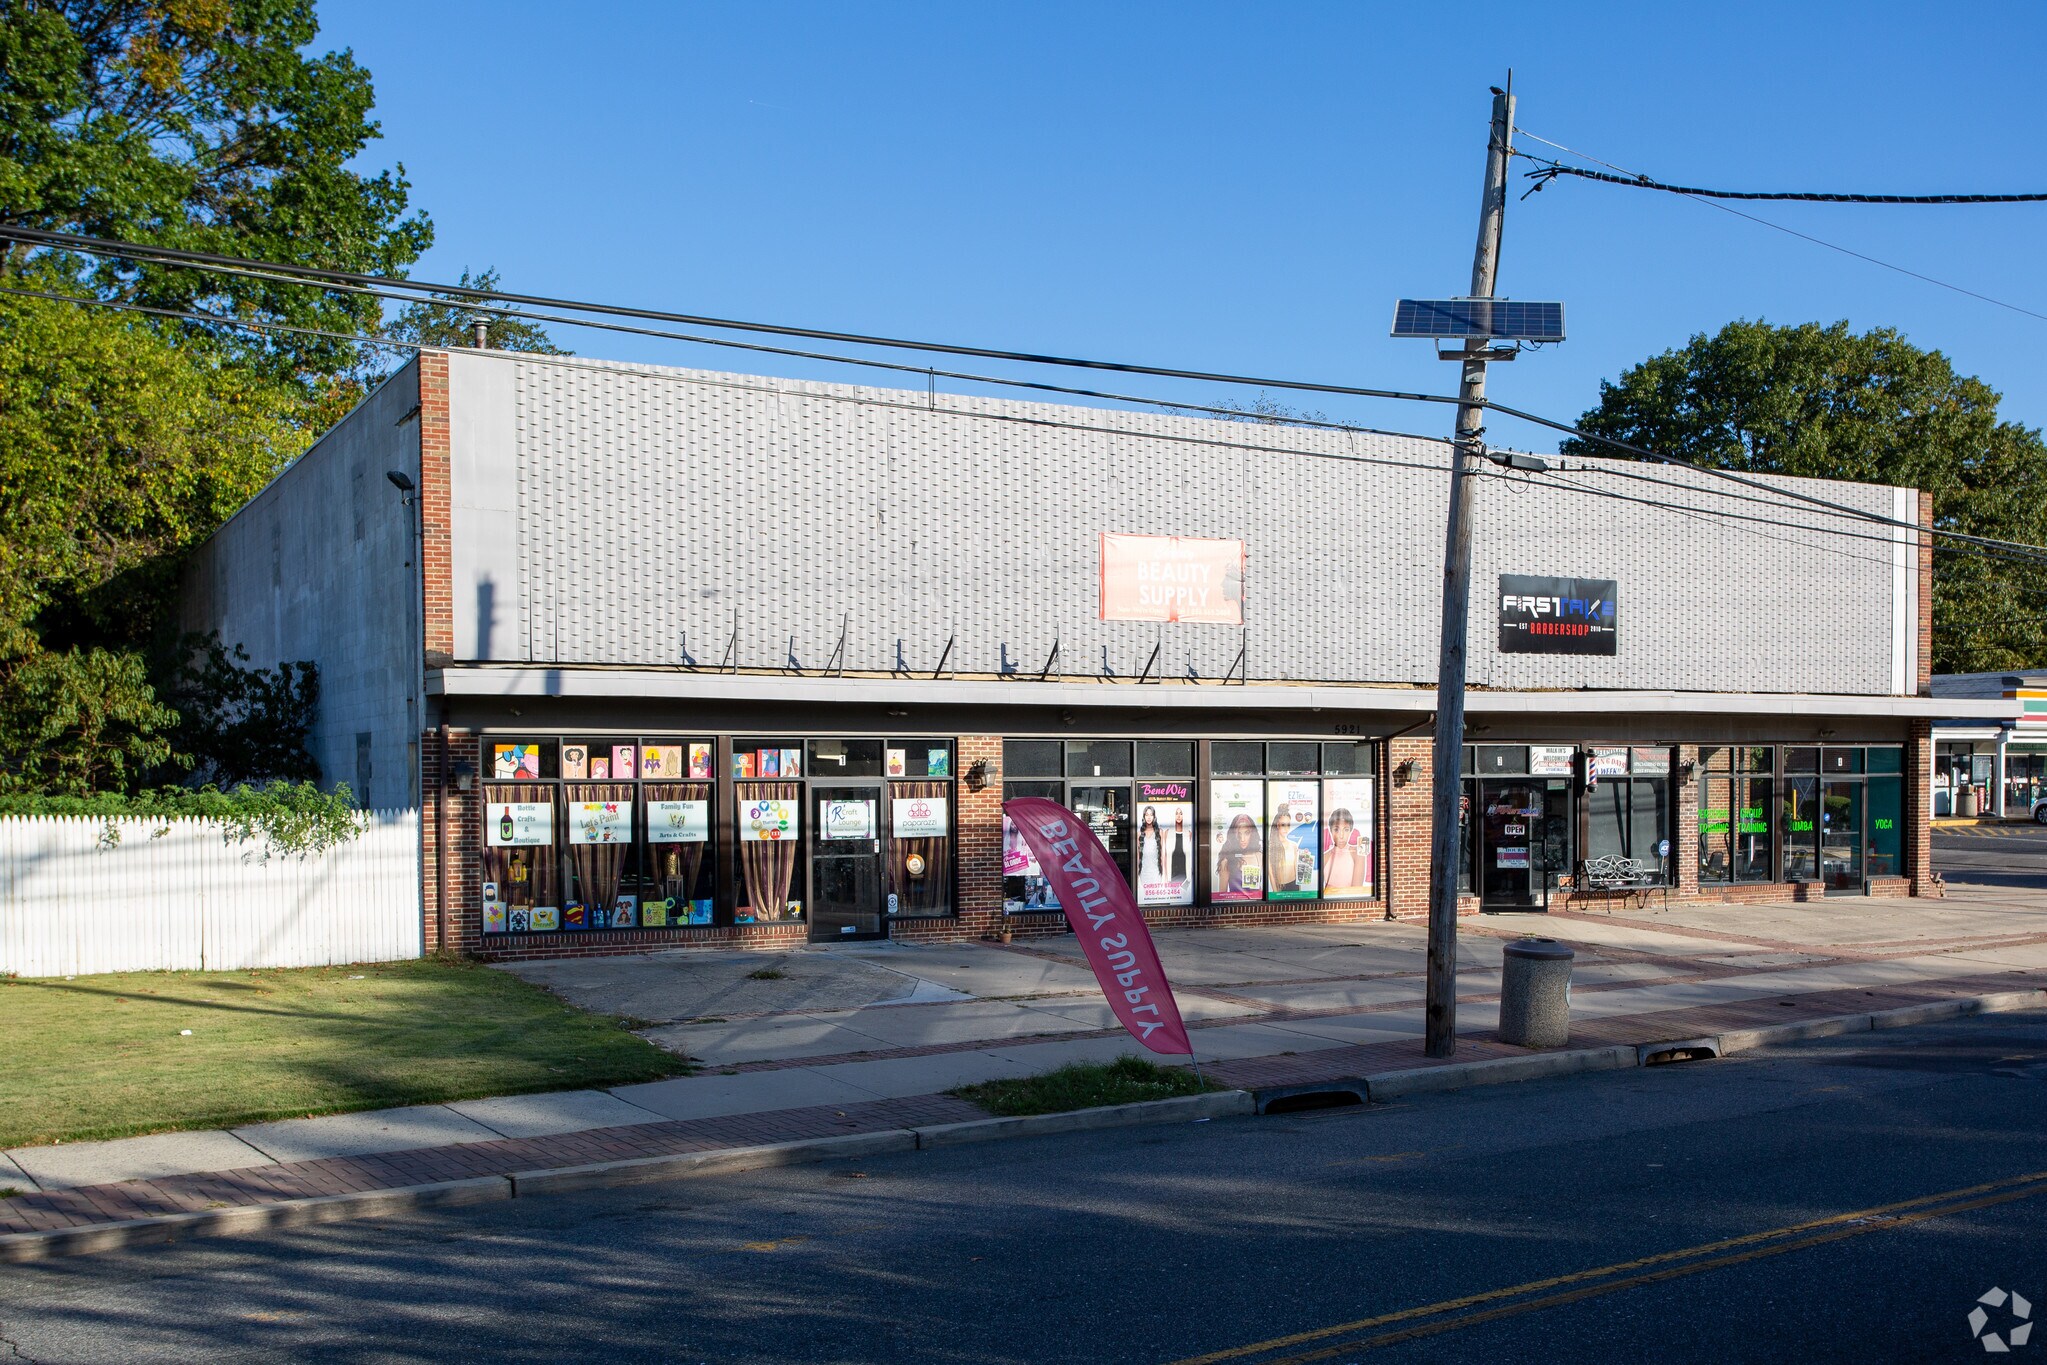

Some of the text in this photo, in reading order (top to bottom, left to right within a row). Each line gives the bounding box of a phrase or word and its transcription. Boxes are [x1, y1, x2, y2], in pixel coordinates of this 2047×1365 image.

[1137, 560, 1211, 583] BEAUTY
[1139, 584, 1210, 606] SUPPLY
[1530, 622, 1589, 636] BARBERSHOP
[1334, 724, 1360, 734] 5921
[840, 755, 845, 764] 1
[1141, 783, 1187, 798] BeneWig
[660, 803, 681, 811] Family
[1740, 807, 1763, 819] GROUP
[838, 819, 861, 828] Lounge
[902, 819, 938, 828] paparazzi
[1506, 825, 1524, 833] OPEN
[1737, 821, 1768, 833] TRAINING
[1875, 818, 1893, 830] YOGA
